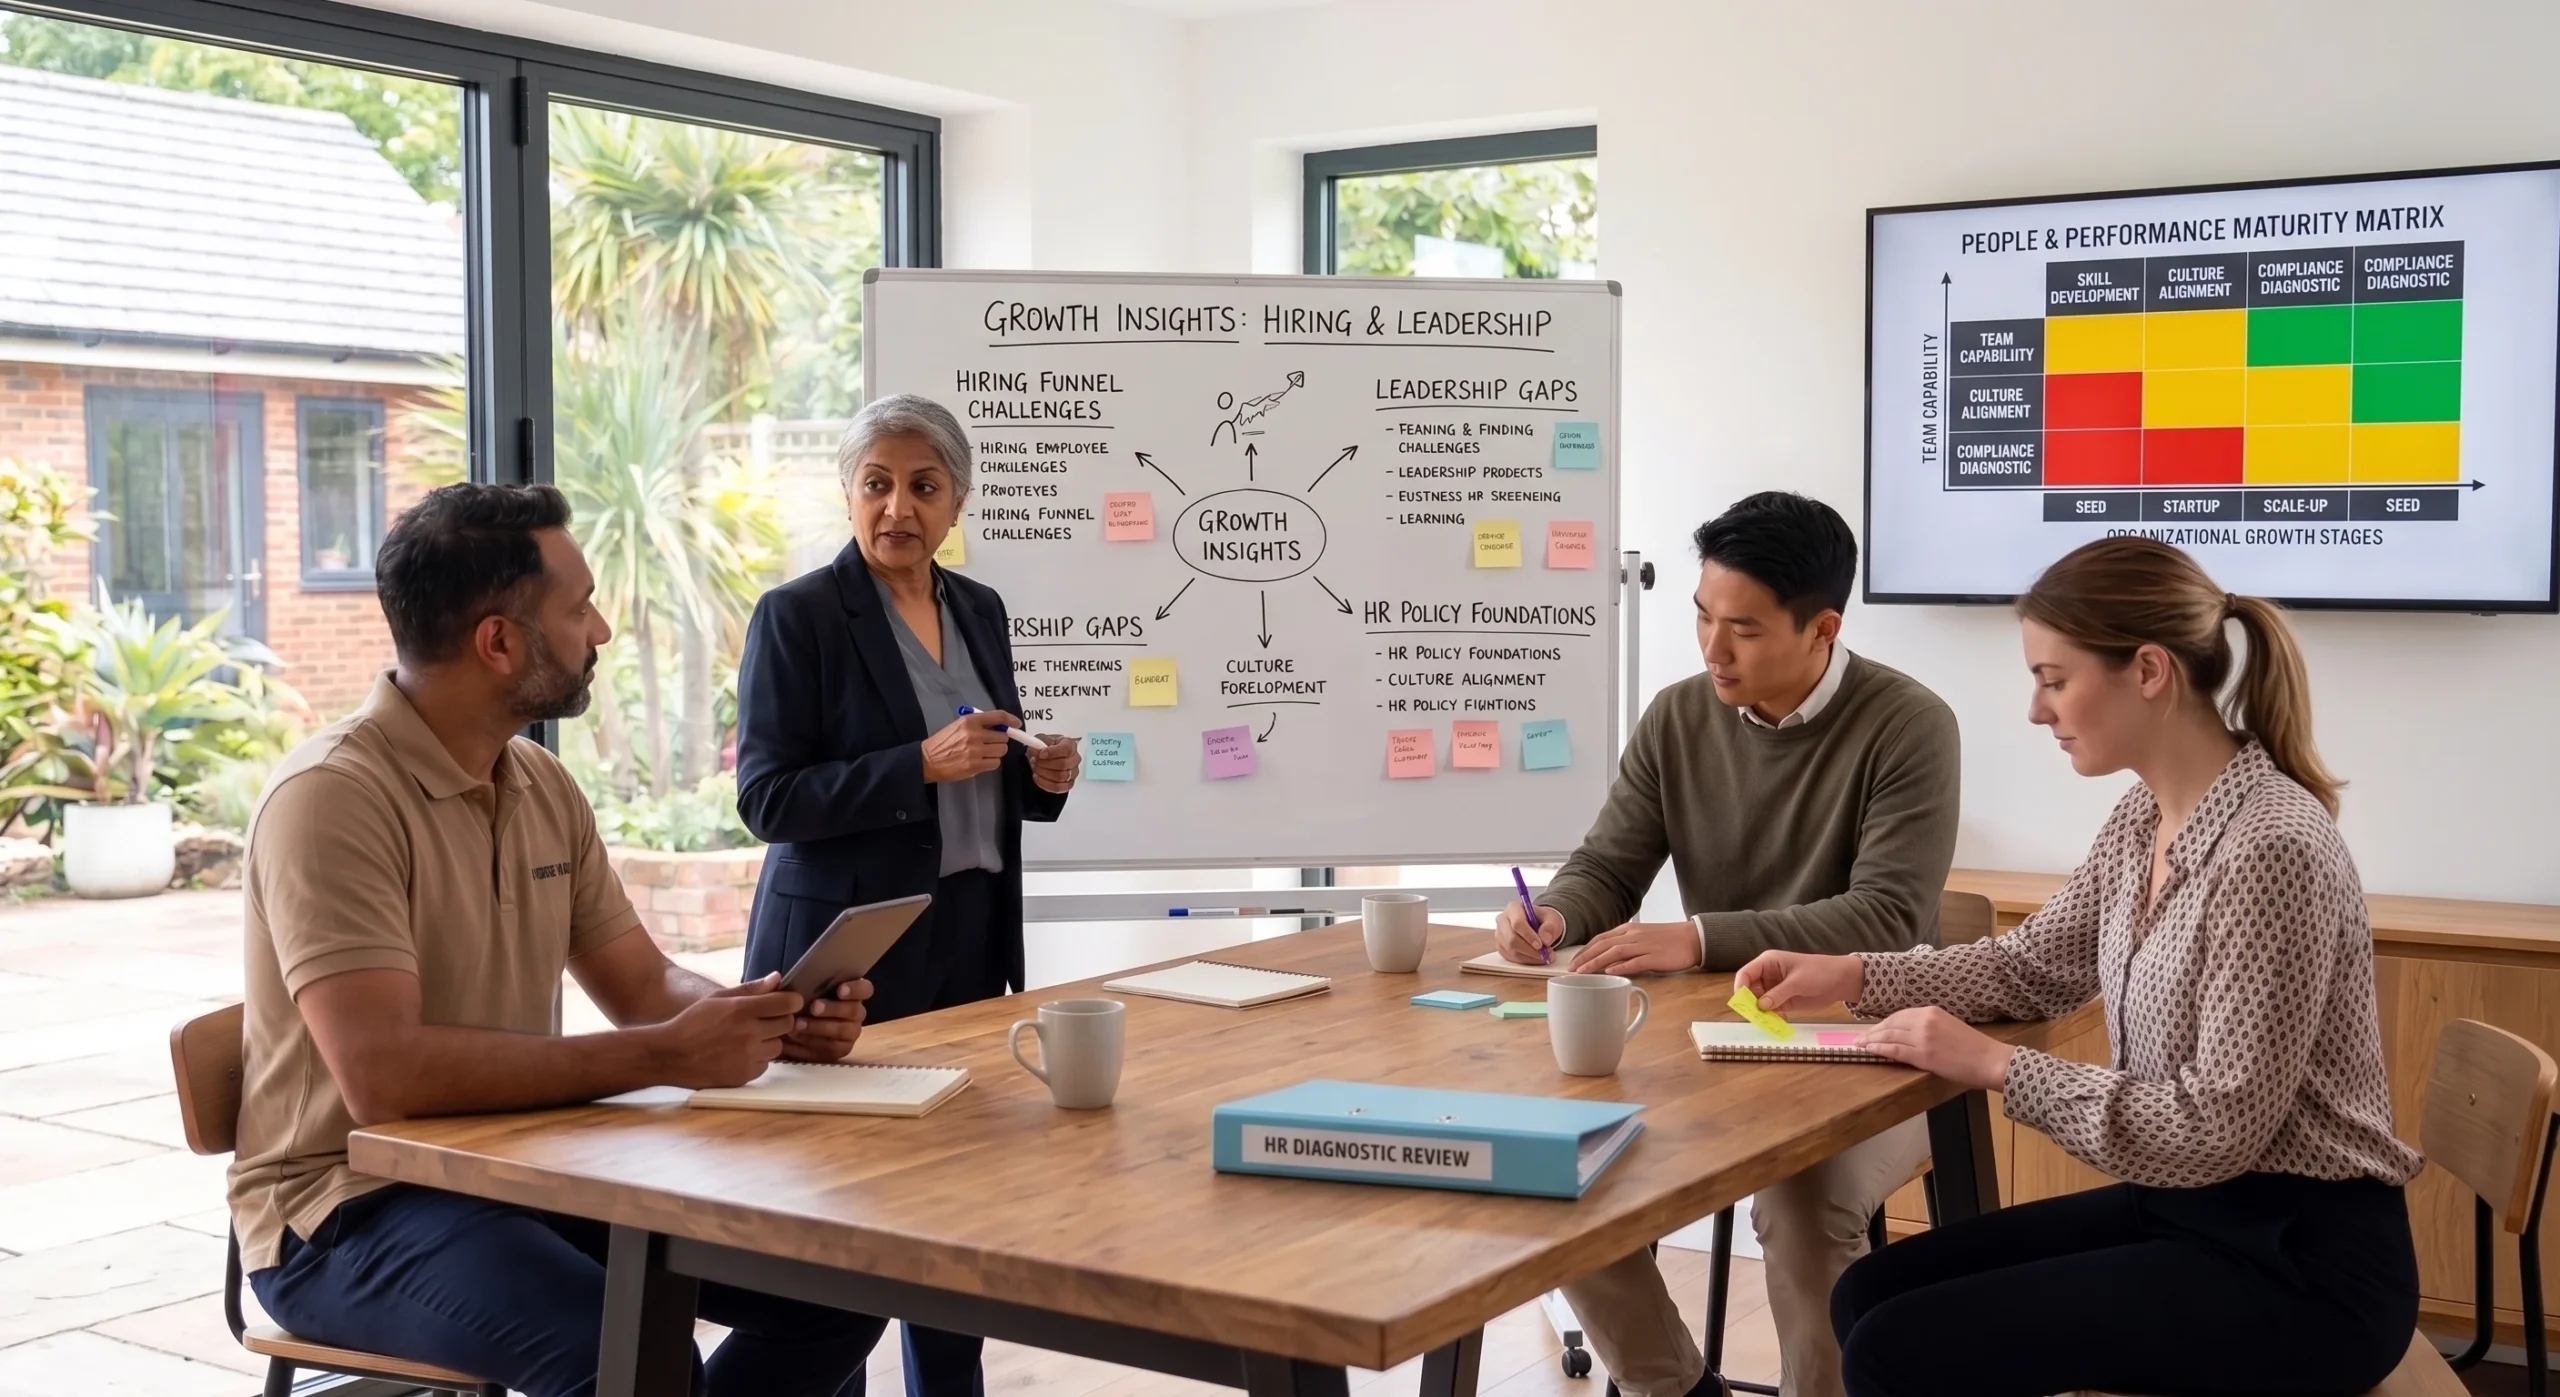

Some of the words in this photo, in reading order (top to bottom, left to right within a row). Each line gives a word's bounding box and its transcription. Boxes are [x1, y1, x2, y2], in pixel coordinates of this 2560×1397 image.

[1962, 229, 2039, 255] PEOPLE
[2044, 228, 2059, 250] &
[2065, 219, 2225, 249] PERFORMANCE
[2233, 210, 2349, 240] MATURITY
[2355, 204, 2445, 233] MATRIX
[2258, 260, 2344, 277] COMPLIANCE
[2364, 254, 2454, 272] COMPLIANCE
[2077, 272, 2112, 287] SKILL
[2168, 266, 2225, 282] CULTURE
[2367, 272, 2450, 290] DIAGNOSTIC
[2159, 283, 2232, 299] ALIGNMENT
[2261, 277, 2341, 294] DIAGNOSTIC
[2051, 287, 2140, 304] DEVELOPMENT
[984, 301, 1098, 336] GROWTH
[1118, 303, 1247, 337] INSIGHTS:
[1264, 304, 1352, 337] HIRING
[1366, 305, 1385, 336] &
[1397, 310, 1552, 337] LEADERSHIP
[1980, 332, 2014, 346] TEAM
[956, 369, 1028, 394] HIRING
[1040, 370, 1124, 393] FUNNEL
[1923, 333, 1938, 419] CAPABILITY
[1376, 379, 1507, 401] LEADERSHIP
[1518, 379, 1578, 403] GAPS
[1969, 388, 2023, 403] CULTURE
[968, 401, 1101, 420] CHALLENGES
[1961, 404, 2031, 419] ALIGNMENT
[1398, 422, 1456, 436] FEANING
[1462, 422, 1473, 437] &
[1479, 423, 1534, 437] FINDING
[980, 441, 1028, 455] HIRING
[1398, 441, 1481, 454] CHALLENGES
[1923, 424, 1937, 464] TEAM
[1957, 444, 2034, 458] COMPLIANCE
[1398, 465, 1477, 479] LEADERSHIP
[1959, 460, 2031, 474] DIAGNOSTIC
[1467, 490, 1484, 502] HR
[2075, 500, 2107, 514] SEED
[2163, 499, 2221, 514] STARTUP
[2263, 498, 2329, 513] SCALE-UP
[2385, 497, 2421, 513] SEED
[981, 507, 1030, 522] HIRING
[1038, 506, 1095, 521] FUNNEL
[1198, 509, 1288, 535] GROWTH
[1399, 512, 1465, 526] LEARNING
[982, 526, 1072, 541] CHALLENGES
[2245, 528, 2316, 545] GROWTH
[2319, 528, 2384, 546] STAGES
[1203, 539, 1302, 564] INSIGHTS
[1364, 600, 1392, 625] HR
[1401, 600, 1462, 625] POLICY
[1471, 601, 1596, 627] FOUNDATIONS
[1085, 615, 1144, 640] GAPS
[1388, 645, 1409, 661] HR
[1416, 645, 1462, 660] POLICY
[1468, 646, 1561, 661] FOUNDATIONS
[1226, 658, 1295, 674] CULTURE
[1220, 680, 1328, 695] FORELOPMENT
[1388, 672, 1455, 687] CULTURE
[1461, 672, 1547, 688] ALIGNMENT
[1388, 698, 1407, 712] HR
[1413, 698, 1458, 712] POLICY
[1264, 1135, 1289, 1155] HR
[1293, 1138, 1397, 1163] DIAGNOSTIC
[1402, 1146, 1470, 1168] REVIEW
